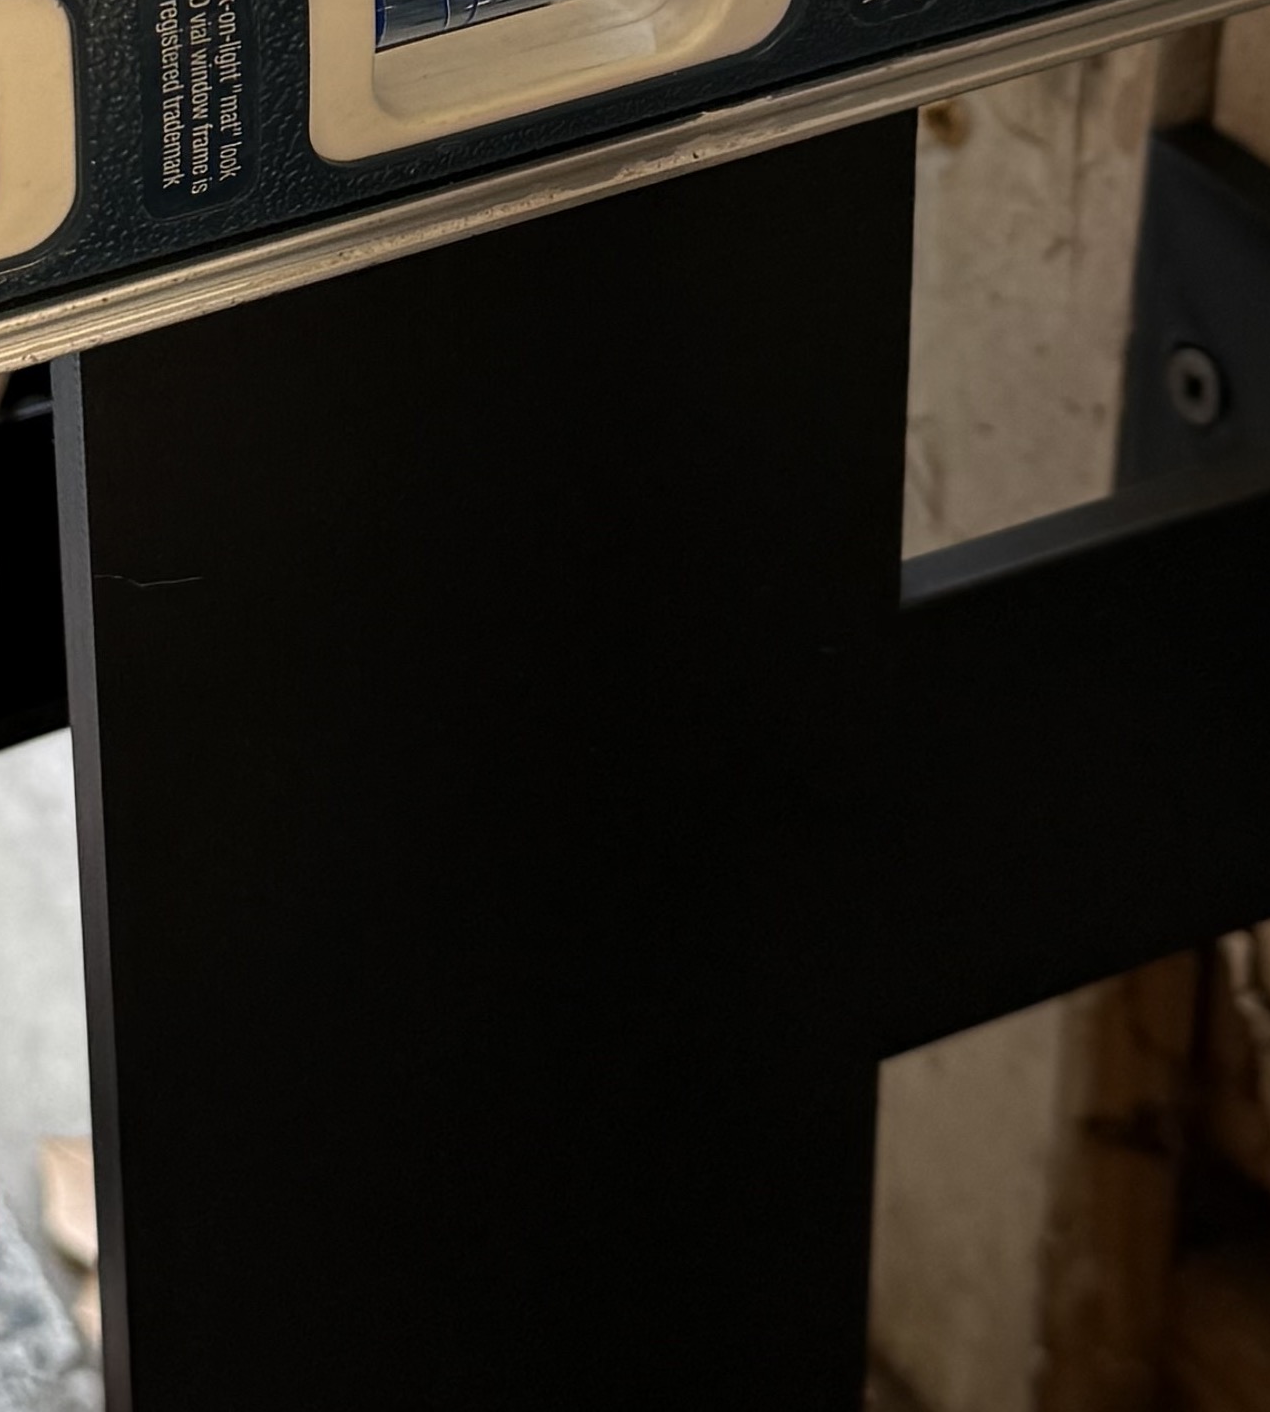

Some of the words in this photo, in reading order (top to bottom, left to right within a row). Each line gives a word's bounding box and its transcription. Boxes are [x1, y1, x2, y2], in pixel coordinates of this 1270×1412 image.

[156, 0, 184, 93] registered
[189, 12, 212, 45] vial
[190, 48, 212, 120] window
[219, 84, 242, 136] "mat"
[162, 95, 185, 188] trademark
[192, 124, 214, 175] frame
[219, 142, 242, 181] look
[191, 178, 212, 194] is
